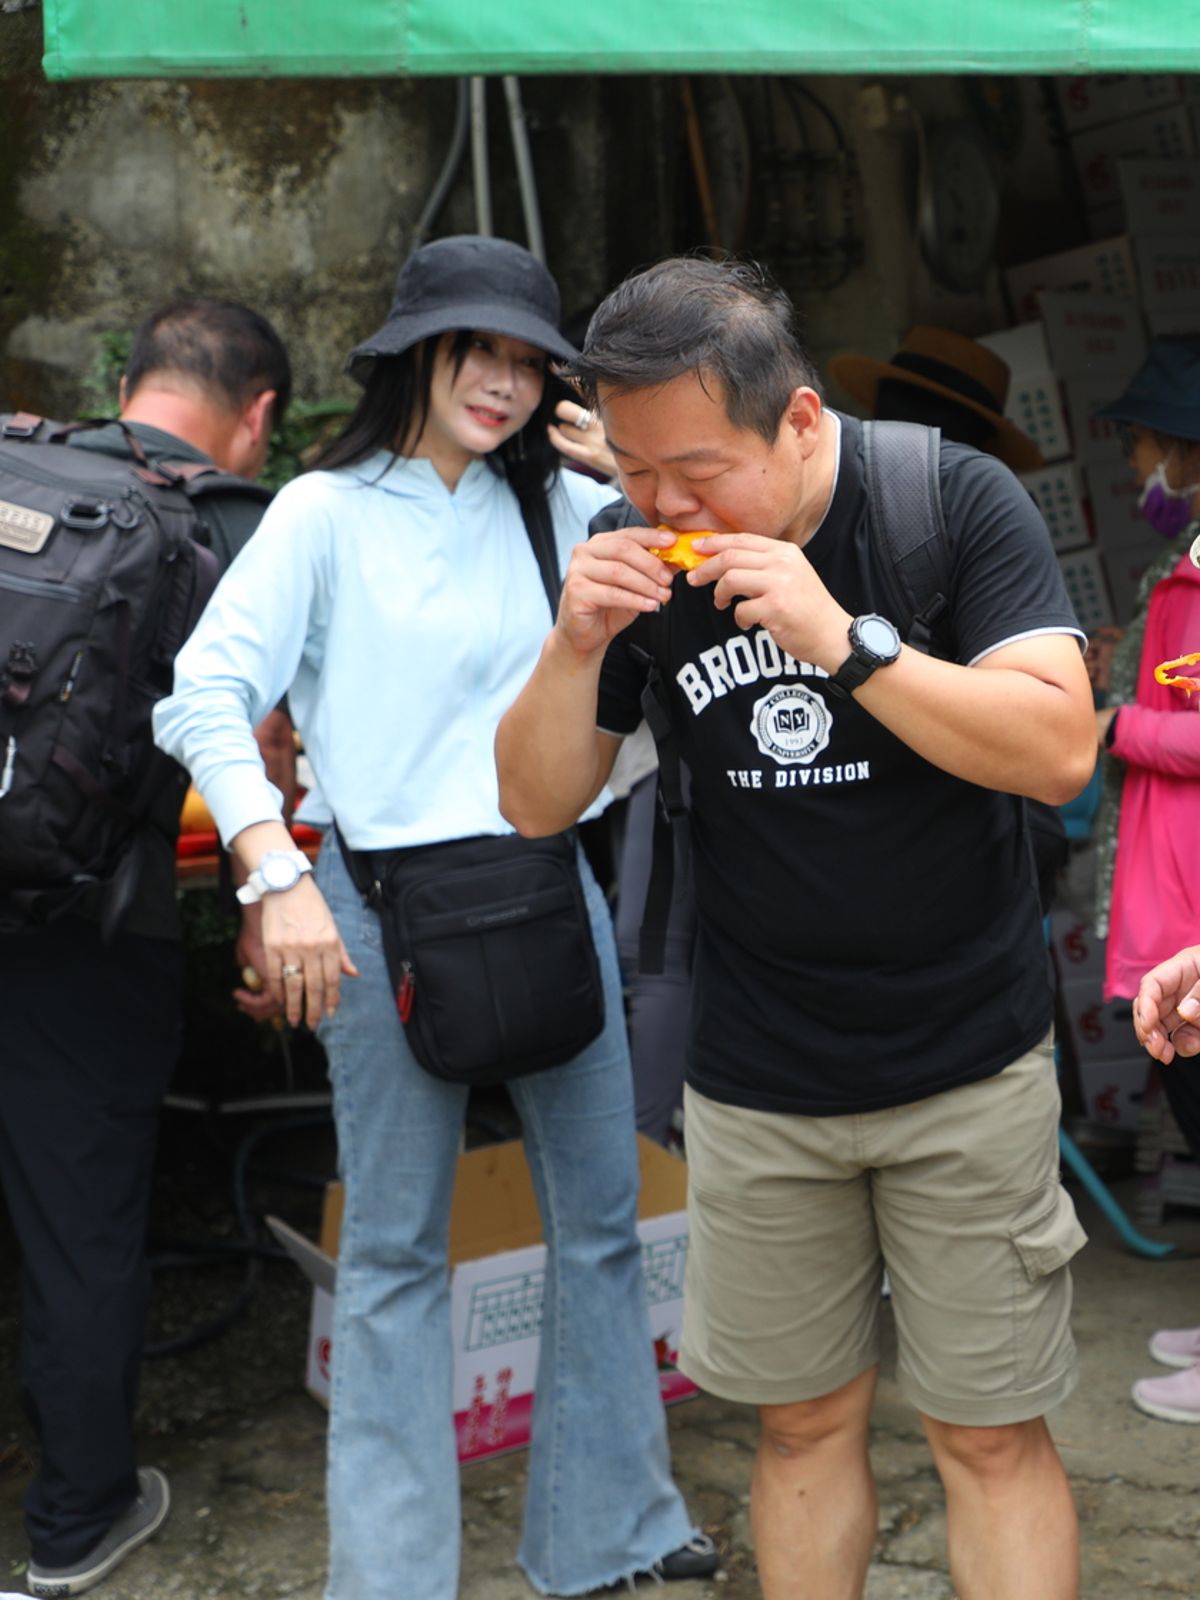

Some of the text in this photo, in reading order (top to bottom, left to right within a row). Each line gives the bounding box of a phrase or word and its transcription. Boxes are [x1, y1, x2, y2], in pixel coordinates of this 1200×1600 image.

[676, 630, 830, 716] BROO
[726, 760, 870, 789] THE DIVISION
